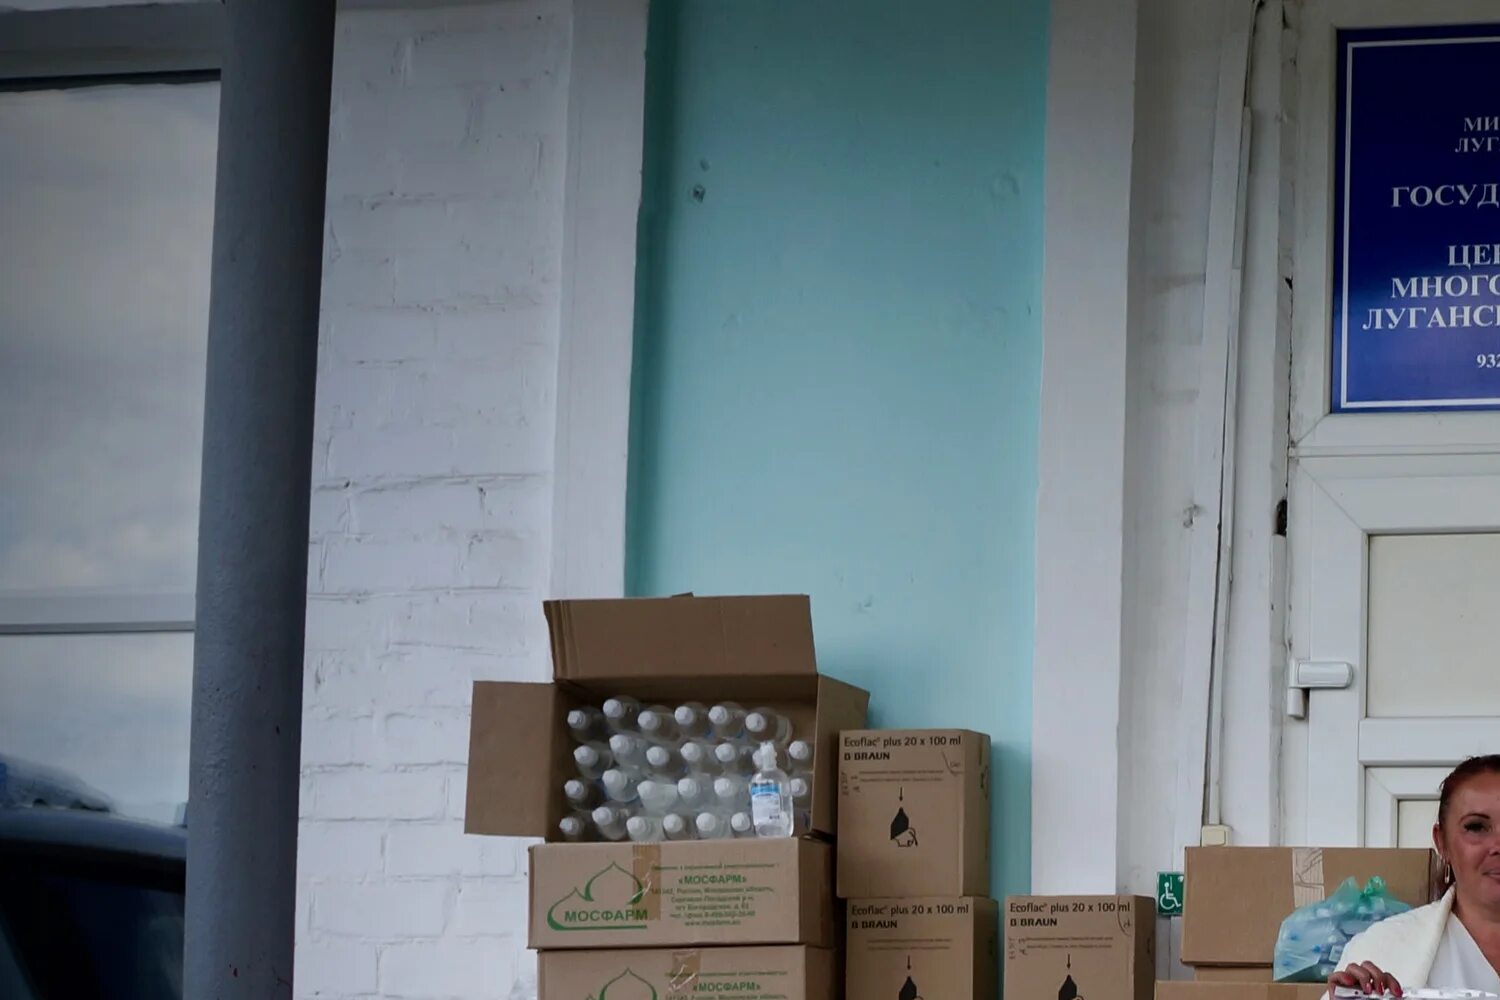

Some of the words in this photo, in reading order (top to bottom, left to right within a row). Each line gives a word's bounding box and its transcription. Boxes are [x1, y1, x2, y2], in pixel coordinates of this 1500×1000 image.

[883, 737, 902, 750] plus
[904, 736, 918, 747] 20
[928, 736, 947, 747] 100
[949, 736, 962, 746] ml
[854, 752, 890, 761] BRAUN
[564, 908, 648, 922] МОСФАРМ
[890, 905, 909, 918] plus
[911, 905, 925, 915] 20
[936, 904, 954, 915] 100
[957, 903, 969, 914] ml
[1050, 903, 1069, 916] plus
[1072, 903, 1085, 913] 20
[1098, 903, 1116, 913] 100
[1118, 902, 1131, 912] ml
[861, 920, 898, 929] BRAUN
[1020, 918, 1058, 927] BRAUN
